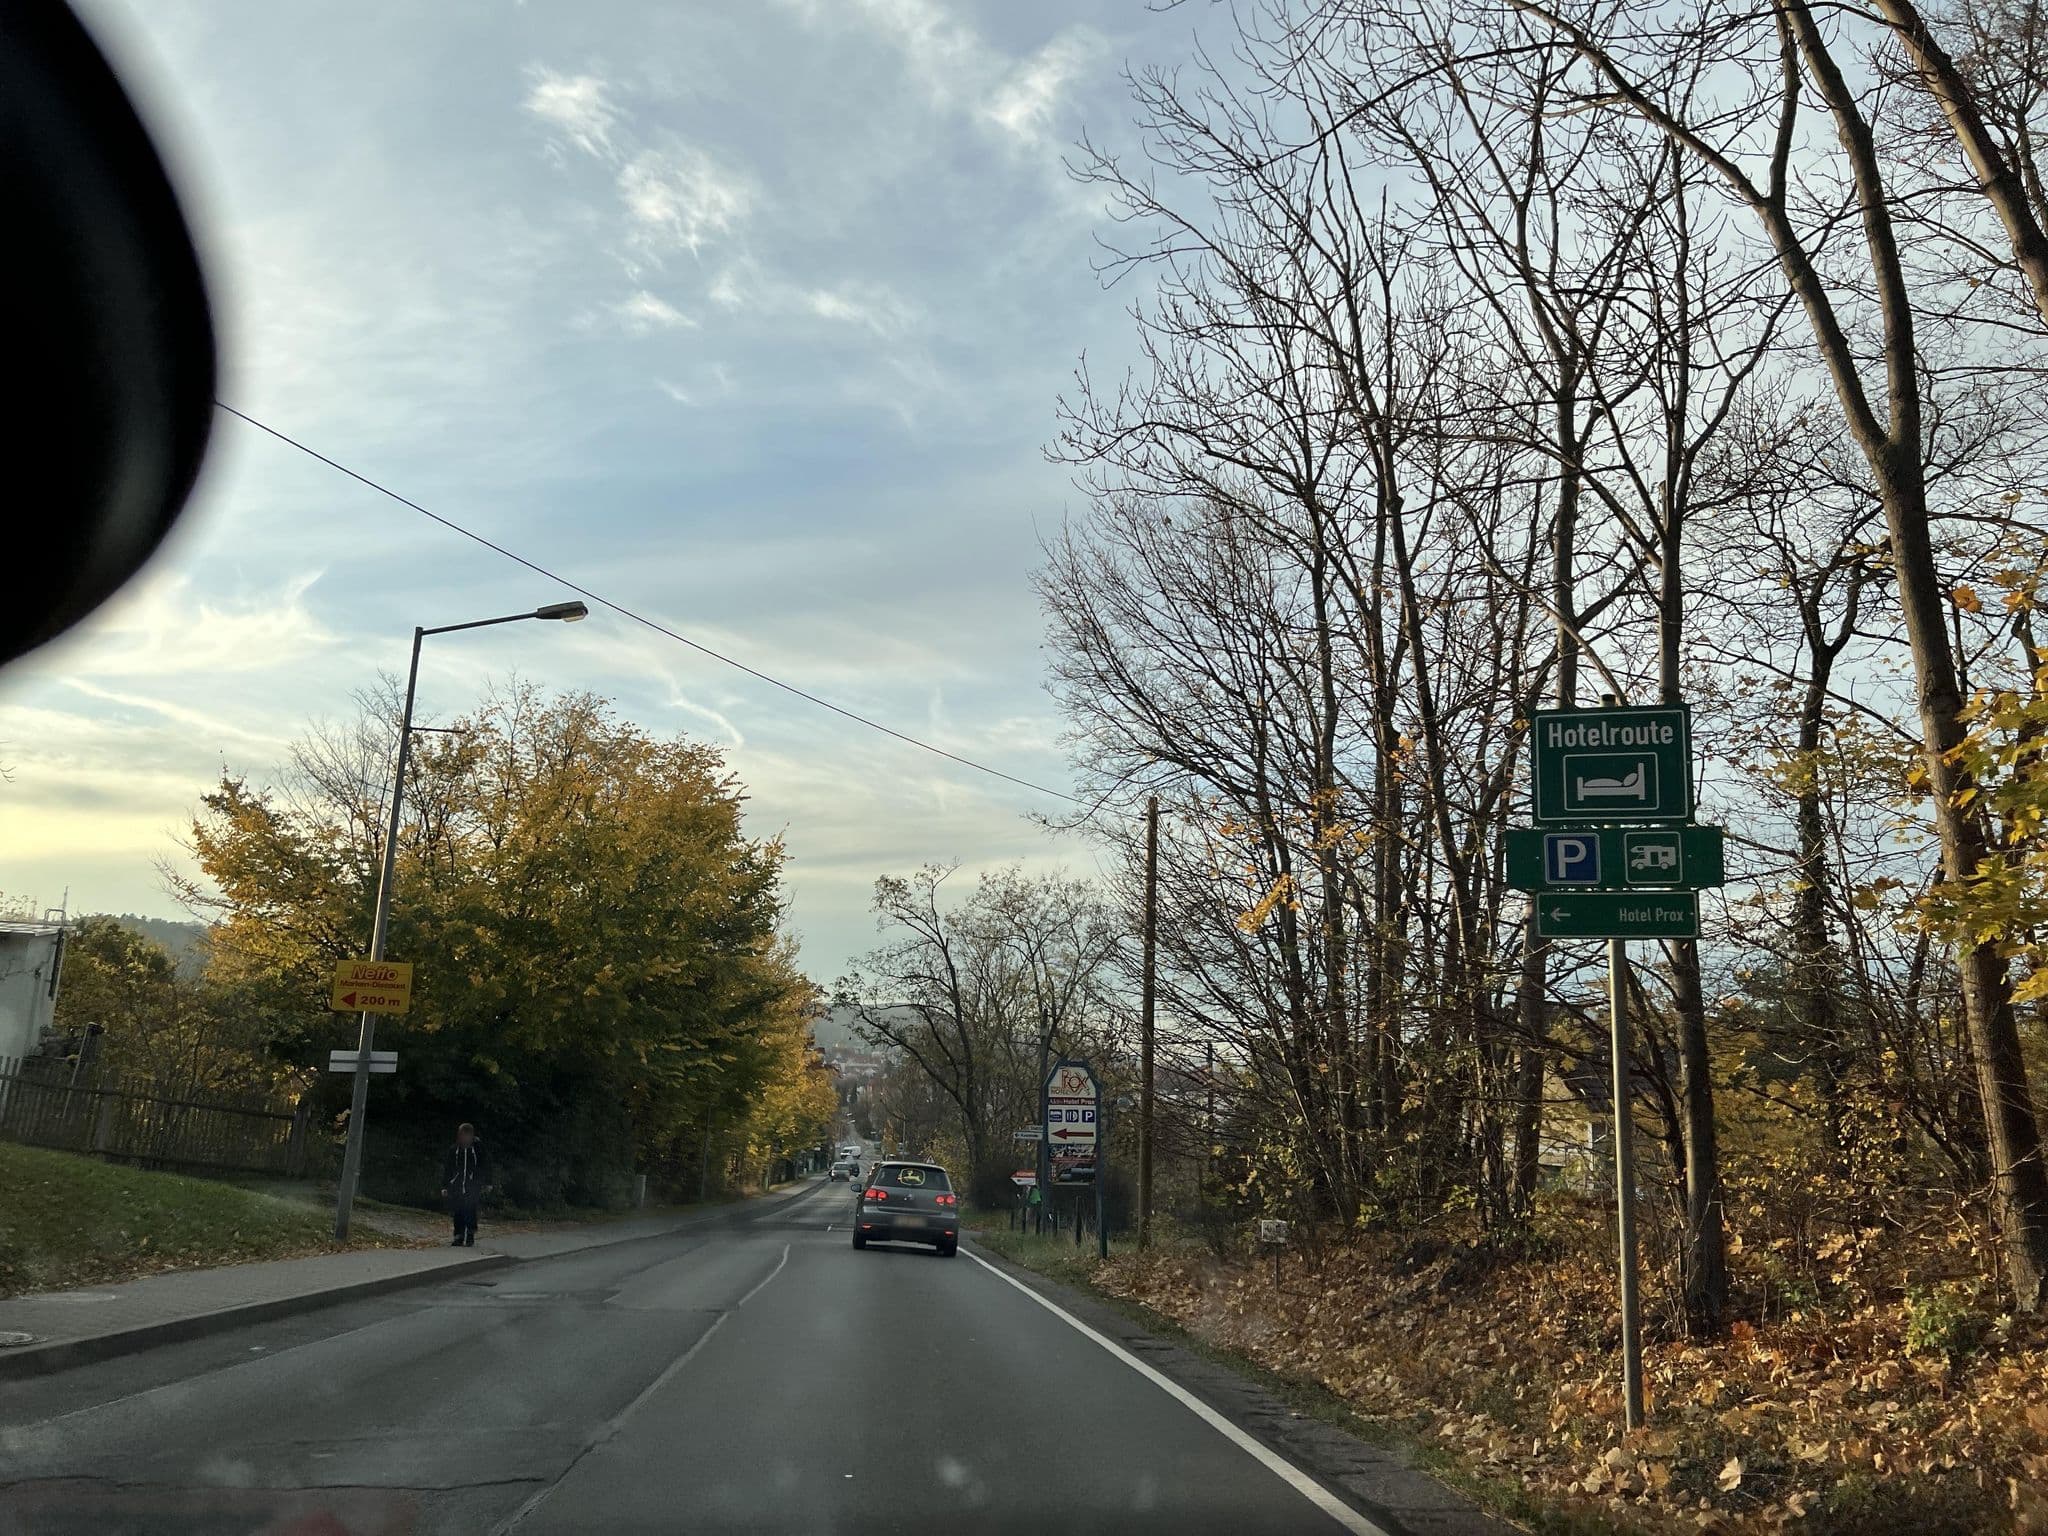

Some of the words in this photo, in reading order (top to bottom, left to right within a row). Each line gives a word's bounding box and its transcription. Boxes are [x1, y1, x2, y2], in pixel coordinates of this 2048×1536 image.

[1548, 721, 1674, 748] Hotelroute
[1556, 839, 1587, 879] P
[1619, 908, 1651, 922] Hotel
[1656, 907, 1684, 922] Prox
[351, 964, 398, 981] Netto
[360, 995, 385, 1005] 200
[1085, 1111, 1093, 1121] P
